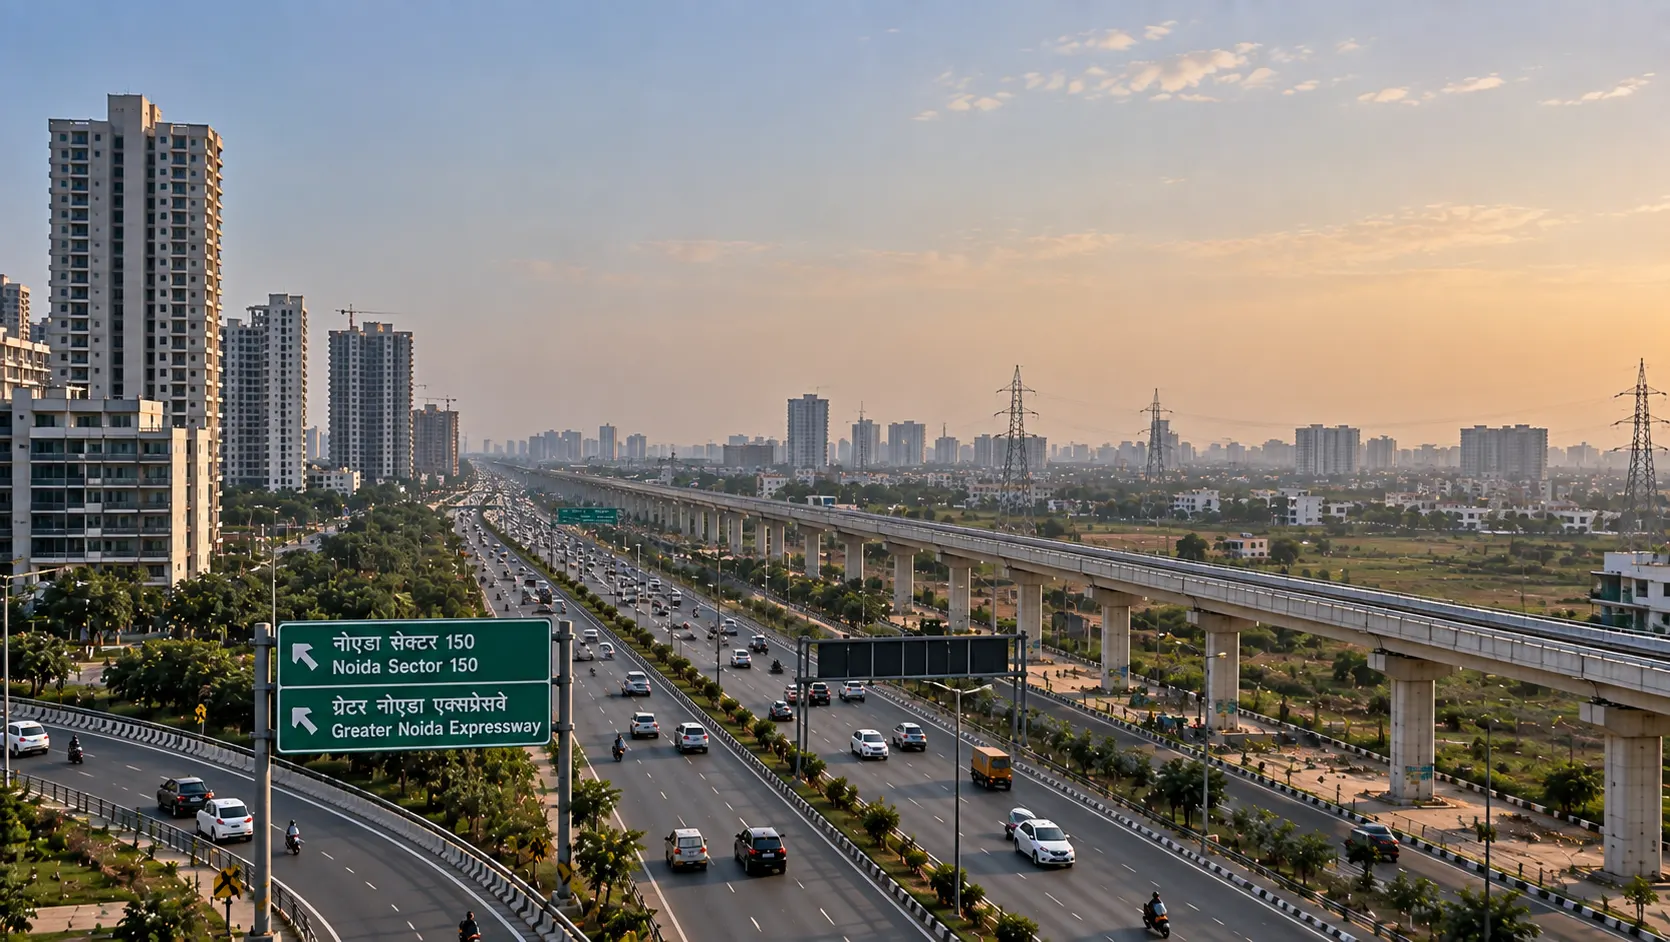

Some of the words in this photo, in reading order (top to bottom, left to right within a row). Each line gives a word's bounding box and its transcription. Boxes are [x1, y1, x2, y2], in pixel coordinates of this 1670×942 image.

[332, 631, 382, 654] नोएडा
[388, 630, 439, 651] सेक्टर
[445, 633, 475, 650] 150
[332, 658, 381, 675] Noida
[388, 658, 444, 674] Sector
[449, 657, 478, 673] 150
[332, 695, 369, 716] ग्रेटर
[375, 694, 426, 717] नोएडा
[432, 691, 509, 715] एक्सप्रेसवे
[331, 723, 393, 739] Greater
[398, 720, 444, 737] Noida
[449, 719, 542, 739] Expressway
